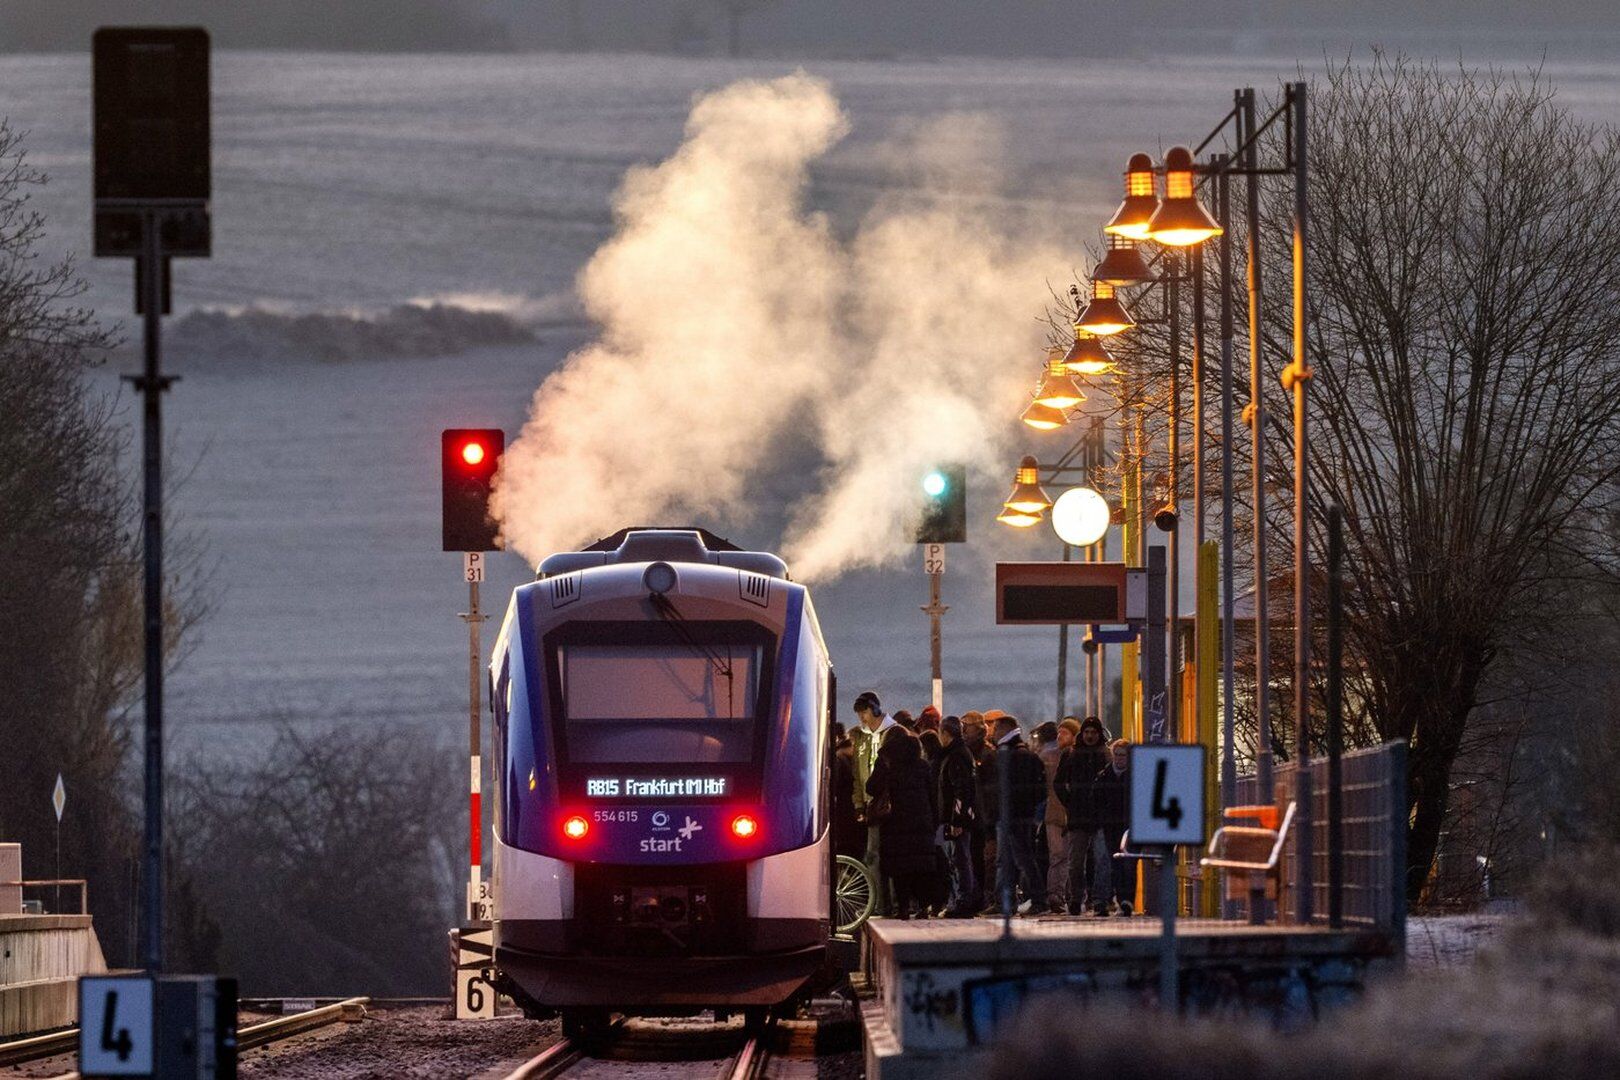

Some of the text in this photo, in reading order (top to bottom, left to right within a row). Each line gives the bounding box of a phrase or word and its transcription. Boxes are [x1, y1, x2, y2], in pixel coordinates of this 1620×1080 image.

[930, 544, 940, 558] P
[470, 553, 480, 566] P
[926, 559, 943, 573] 32
[467, 568, 481, 581] 31
[587, 778, 726, 796] RB15 Frankfurt (M) Hbf
[1151, 757, 1183, 830] 4
[594, 810, 638, 822] 554 615
[640, 837, 682, 852] start
[466, 975, 484, 1012] 6
[101, 988, 133, 1063] 4
